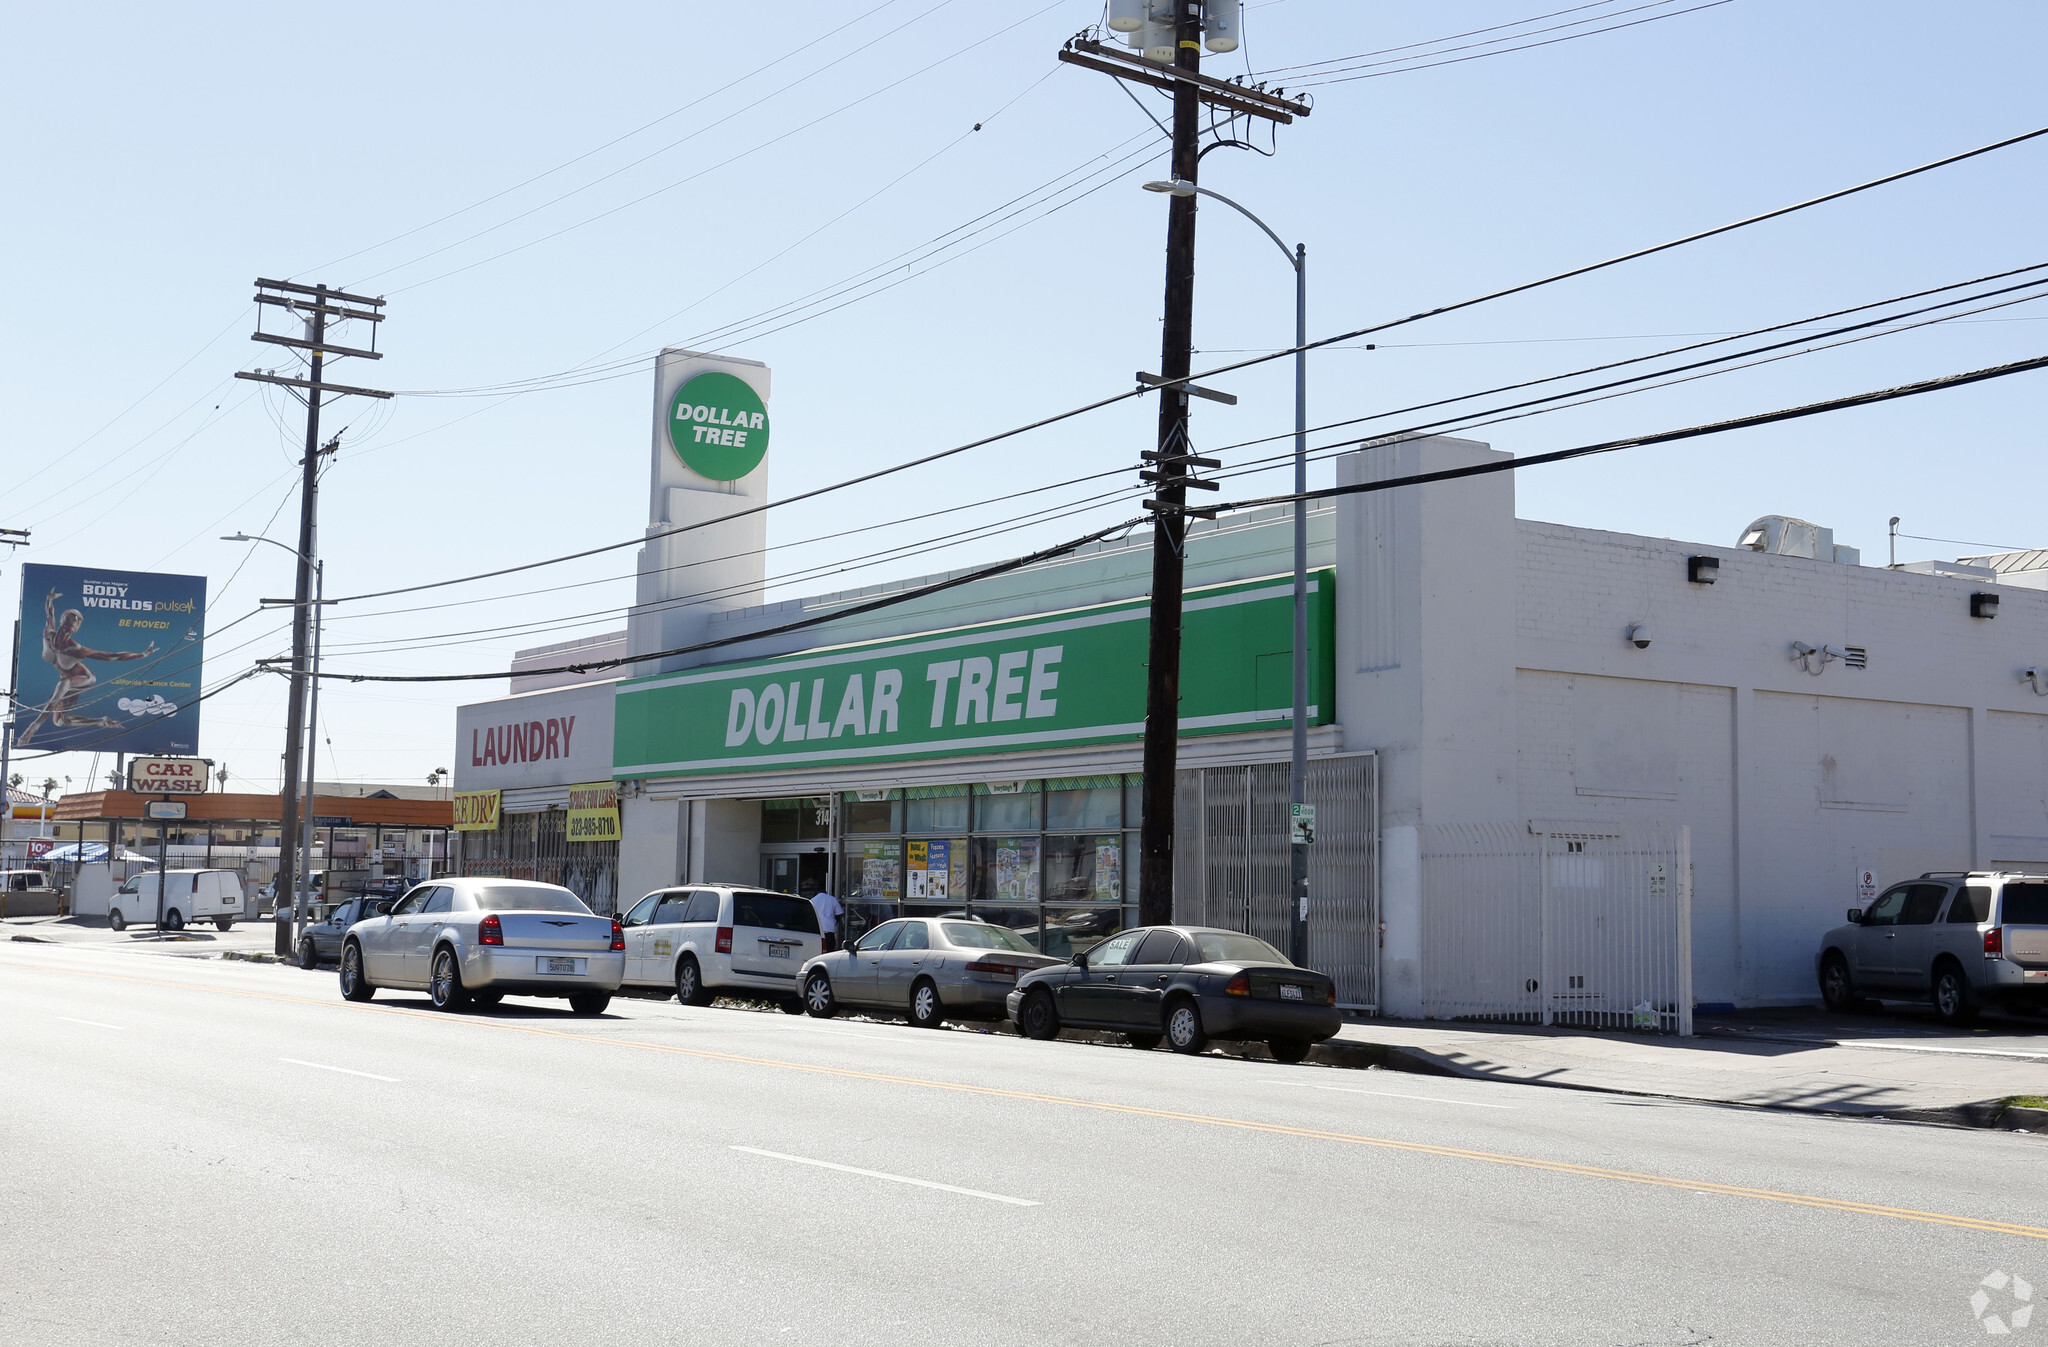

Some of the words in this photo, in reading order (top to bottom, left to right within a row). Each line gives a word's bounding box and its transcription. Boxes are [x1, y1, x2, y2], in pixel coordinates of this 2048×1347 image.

[676, 403, 765, 430] DOLLAR
[692, 425, 748, 448] TREE
[82, 584, 128, 597] BODY
[82, 596, 152, 611] WORLDS
[155, 600, 190, 612] pulse
[118, 619, 131, 627] BE
[133, 620, 170, 629] MOVED!
[724, 668, 903, 747] DOLLAR
[926, 645, 1064, 728] TREE
[472, 715, 576, 767] LAUNDRY
[146, 763, 194, 776] CAR
[132, 779, 202, 792] WASH
[569, 790, 587, 810] SPACE
[587, 789, 598, 809] FOR
[599, 789, 617, 808] LEASE
[470, 794, 497, 824] DRY
[1293, 805, 1299, 815] 2
[1293, 817, 1314, 826] PARKING
[1110, 940, 1129, 950] SALE
